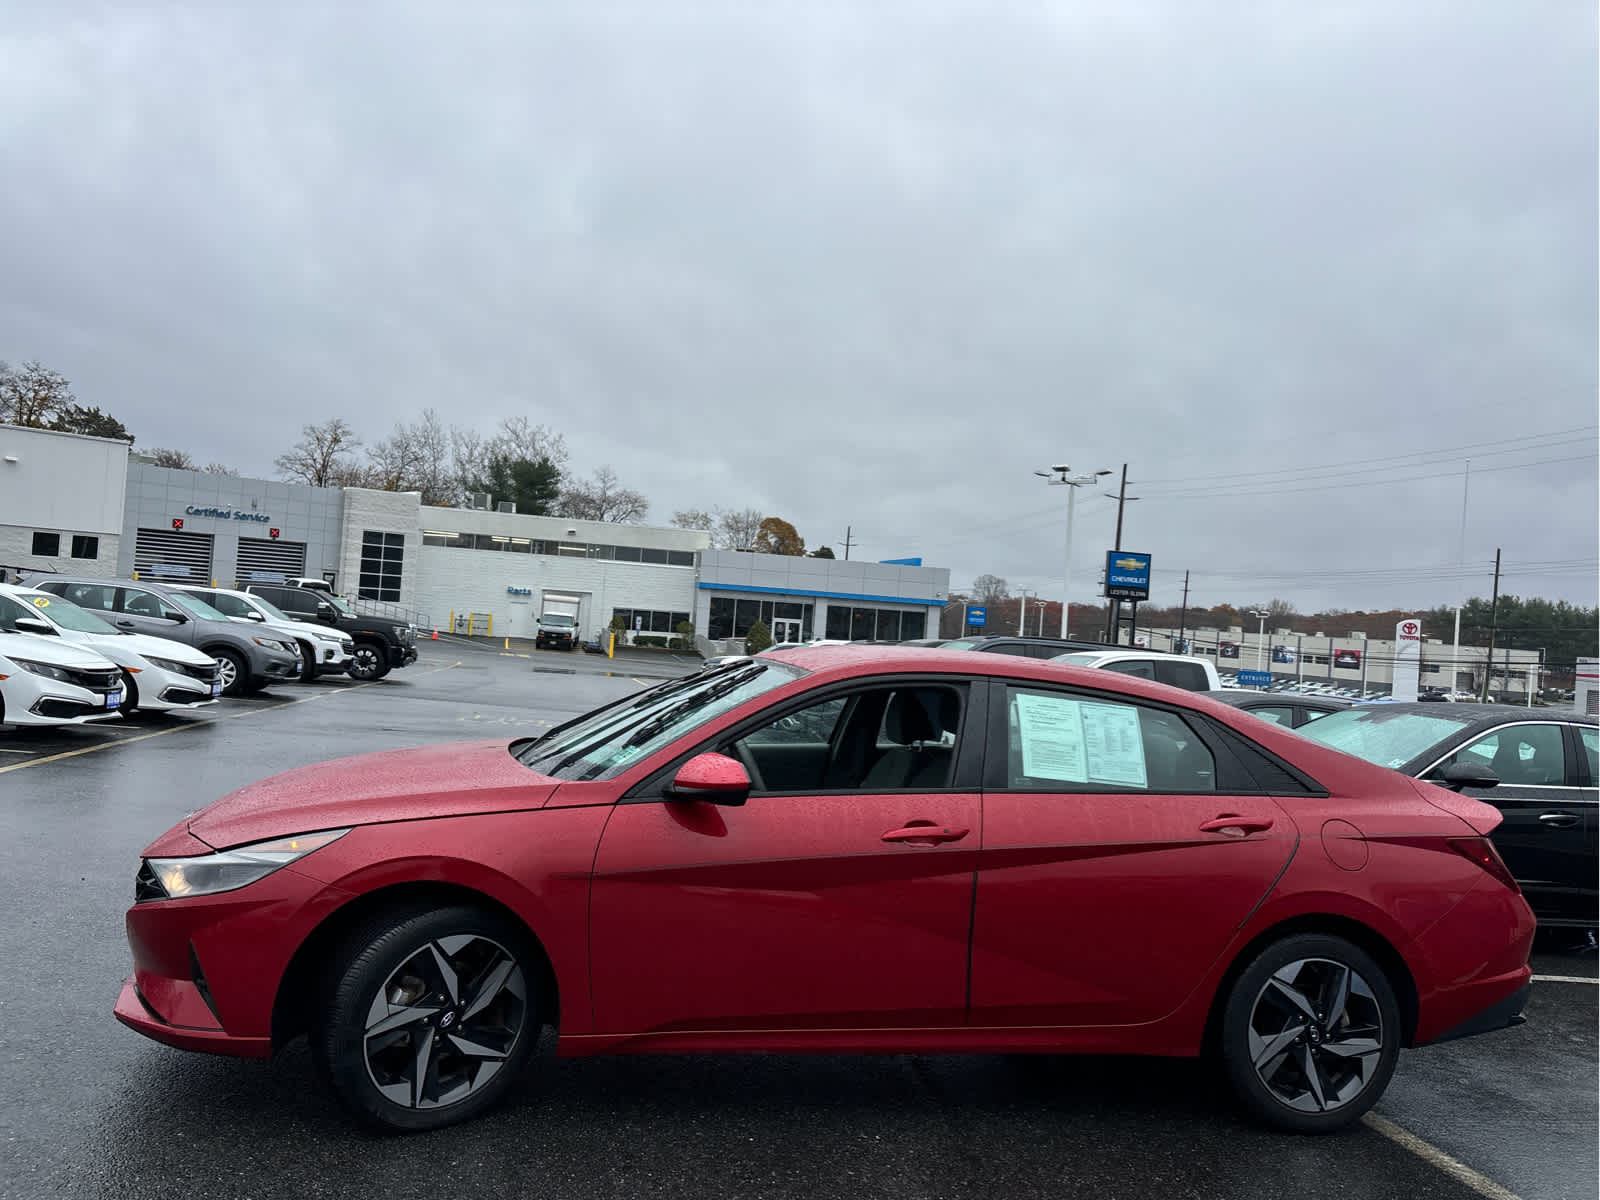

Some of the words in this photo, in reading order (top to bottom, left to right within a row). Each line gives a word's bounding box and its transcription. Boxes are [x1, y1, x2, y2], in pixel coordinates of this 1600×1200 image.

[186, 506, 231, 519] Certified
[233, 511, 270, 523] Service
[1111, 576, 1146, 584] CHEVROLET
[507, 586, 532, 596] Parts
[1240, 674, 1270, 682] ENTRANCE
